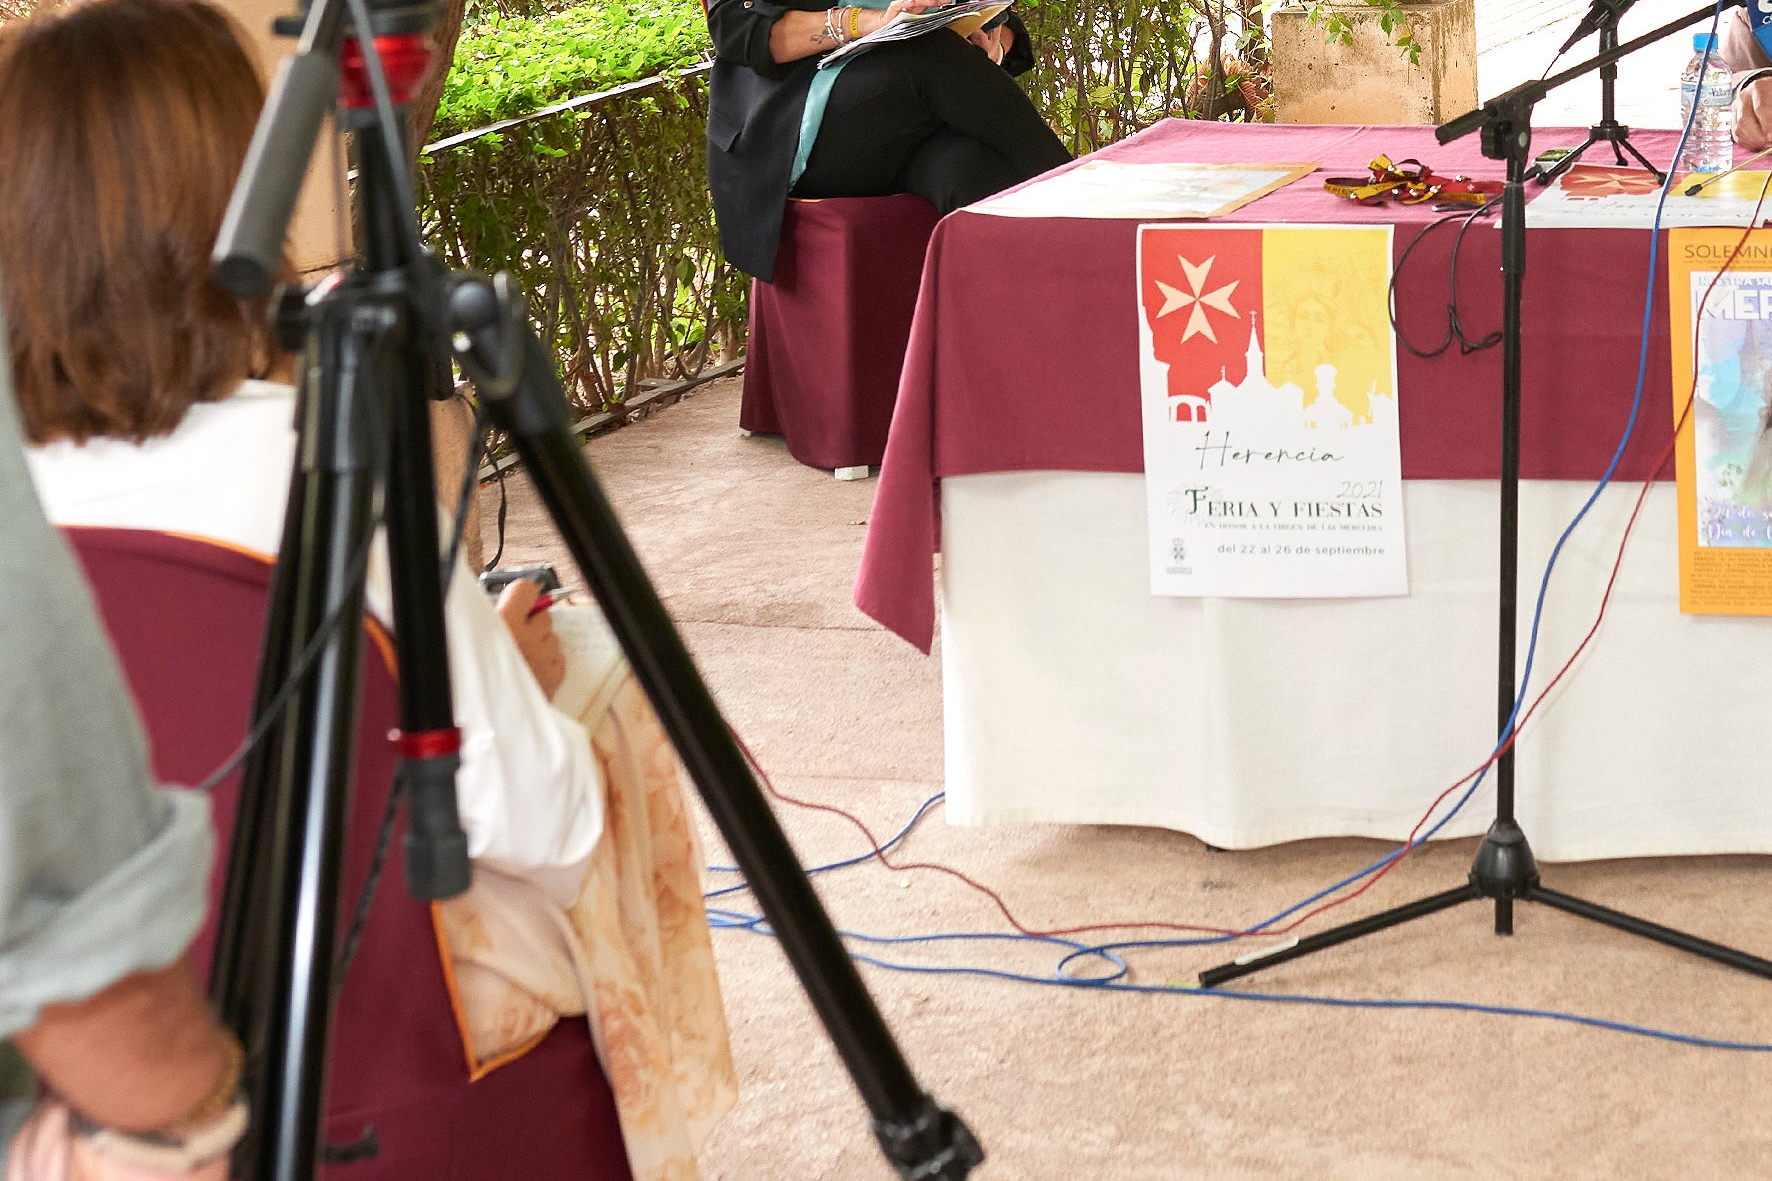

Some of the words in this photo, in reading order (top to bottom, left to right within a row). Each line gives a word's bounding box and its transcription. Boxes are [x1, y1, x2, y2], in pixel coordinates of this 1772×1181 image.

[1195, 430, 1345, 469] Herencia
[1336, 480, 1383, 499] 2021
[1185, 486, 1258, 517] FERIA
[1270, 501, 1281, 517] Y
[1294, 501, 1383, 518] FIESTAS
[1738, 506, 1753, 519] de
[1743, 524, 1756, 538] de
[1217, 545, 1236, 554] del
[1241, 545, 1255, 554] 22
[1261, 545, 1271, 554] al
[1276, 545, 1291, 555] 26
[1296, 545, 1310, 555] de
[1316, 545, 1385, 557] septiembre
